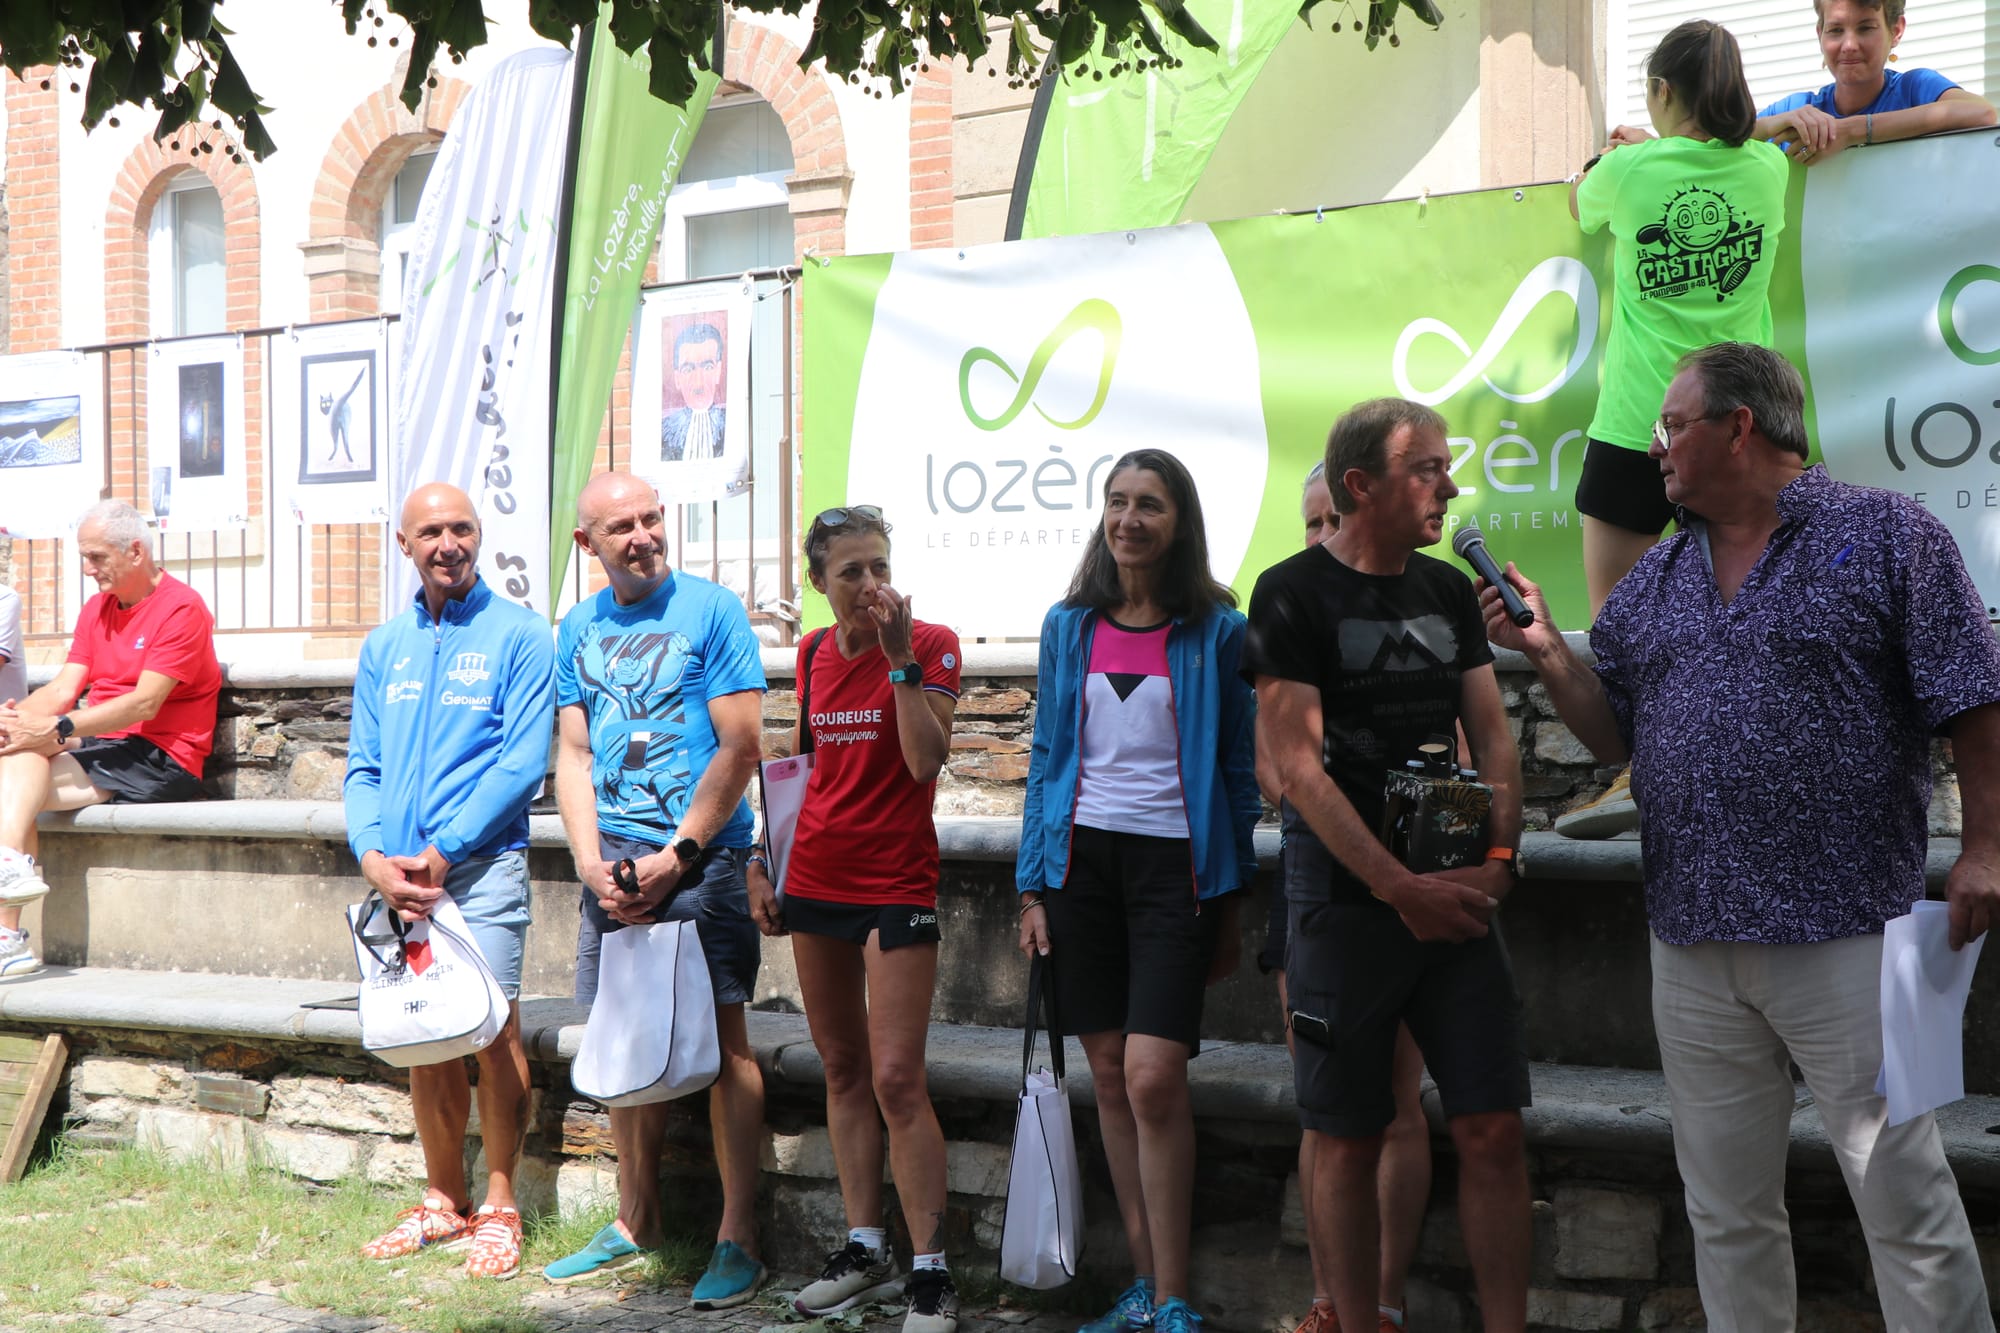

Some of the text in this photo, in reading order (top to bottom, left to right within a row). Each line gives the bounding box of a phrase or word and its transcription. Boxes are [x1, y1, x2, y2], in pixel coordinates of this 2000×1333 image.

[1637, 248, 1648, 259] LA
[1638, 234, 1760, 288] CASTAGNE
[1640, 293, 1649, 301] LE
[1649, 283, 1689, 299] POMPIDOU
[1446, 419, 1583, 496] zèr
[926, 444, 1114, 516] lozèr
[926, 528, 1089, 549] LE DÉPARTE
[810, 709, 882, 727] COUREUSE
[815, 729, 879, 748] Bourguignonne
[404, 1000, 428, 1015] FHP
